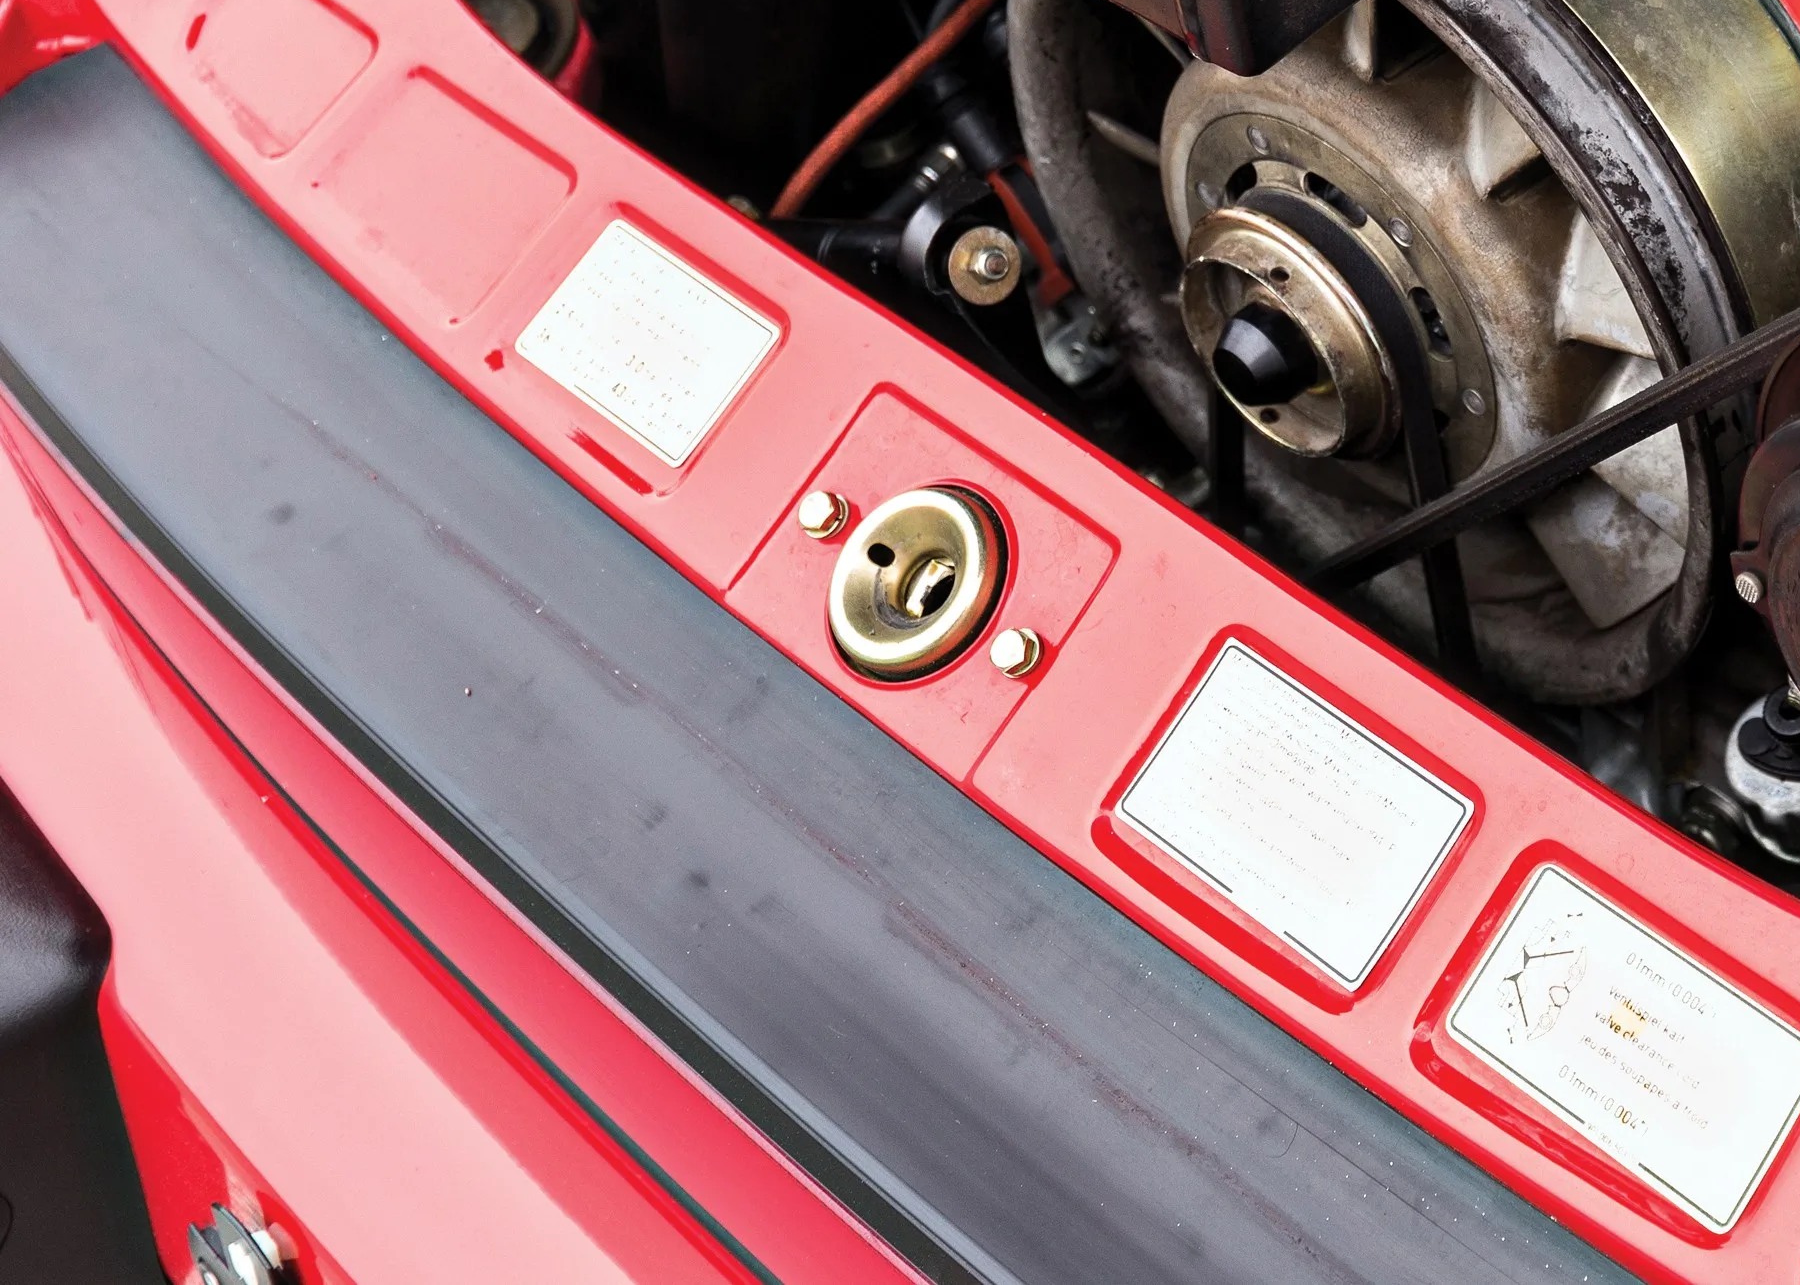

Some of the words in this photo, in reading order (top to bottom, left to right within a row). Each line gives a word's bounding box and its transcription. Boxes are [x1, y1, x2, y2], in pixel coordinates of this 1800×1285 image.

[1625, 951, 1666, 990] 01mm
[1594, 1010, 1622, 1034] valve
[1622, 1030, 1675, 1071] clearance
[1558, 1064, 1599, 1101] 01mm
[1600, 1094, 1649, 1137] (0004")
[1598, 1045, 1618, 1065] des
[1619, 1060, 1671, 1104] soupapes
